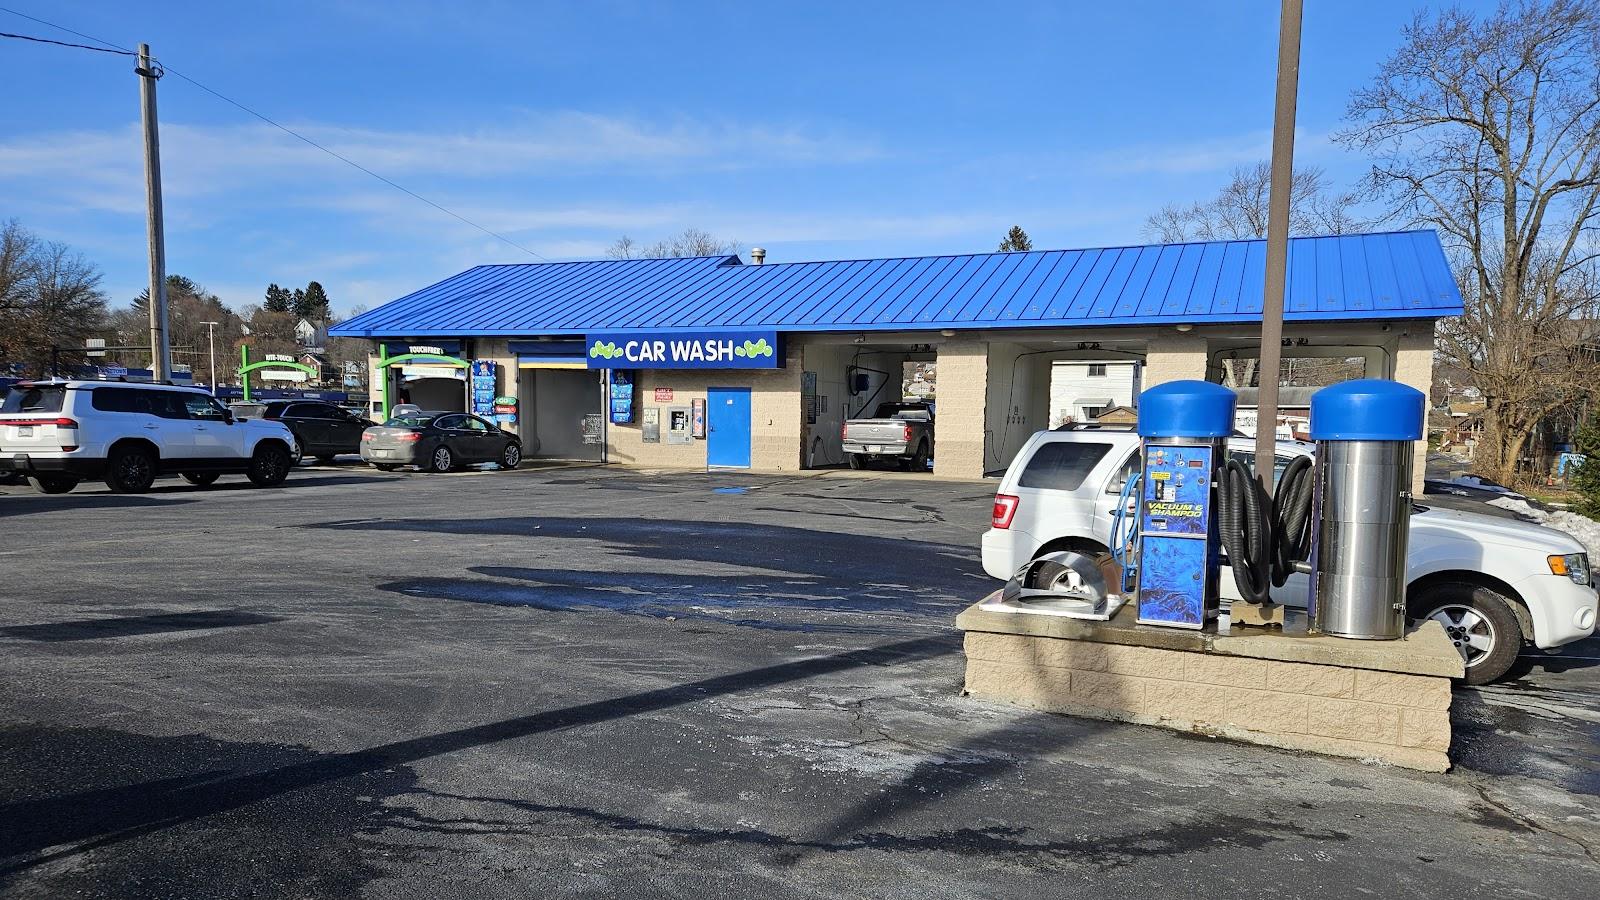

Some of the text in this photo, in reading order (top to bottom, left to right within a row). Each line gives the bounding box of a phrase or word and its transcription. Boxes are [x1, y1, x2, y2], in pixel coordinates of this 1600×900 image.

[625, 339, 734, 362] CAR WASH
[1148, 502, 1192, 511] VACUUM
[1150, 509, 1202, 517] SHAMPOO
